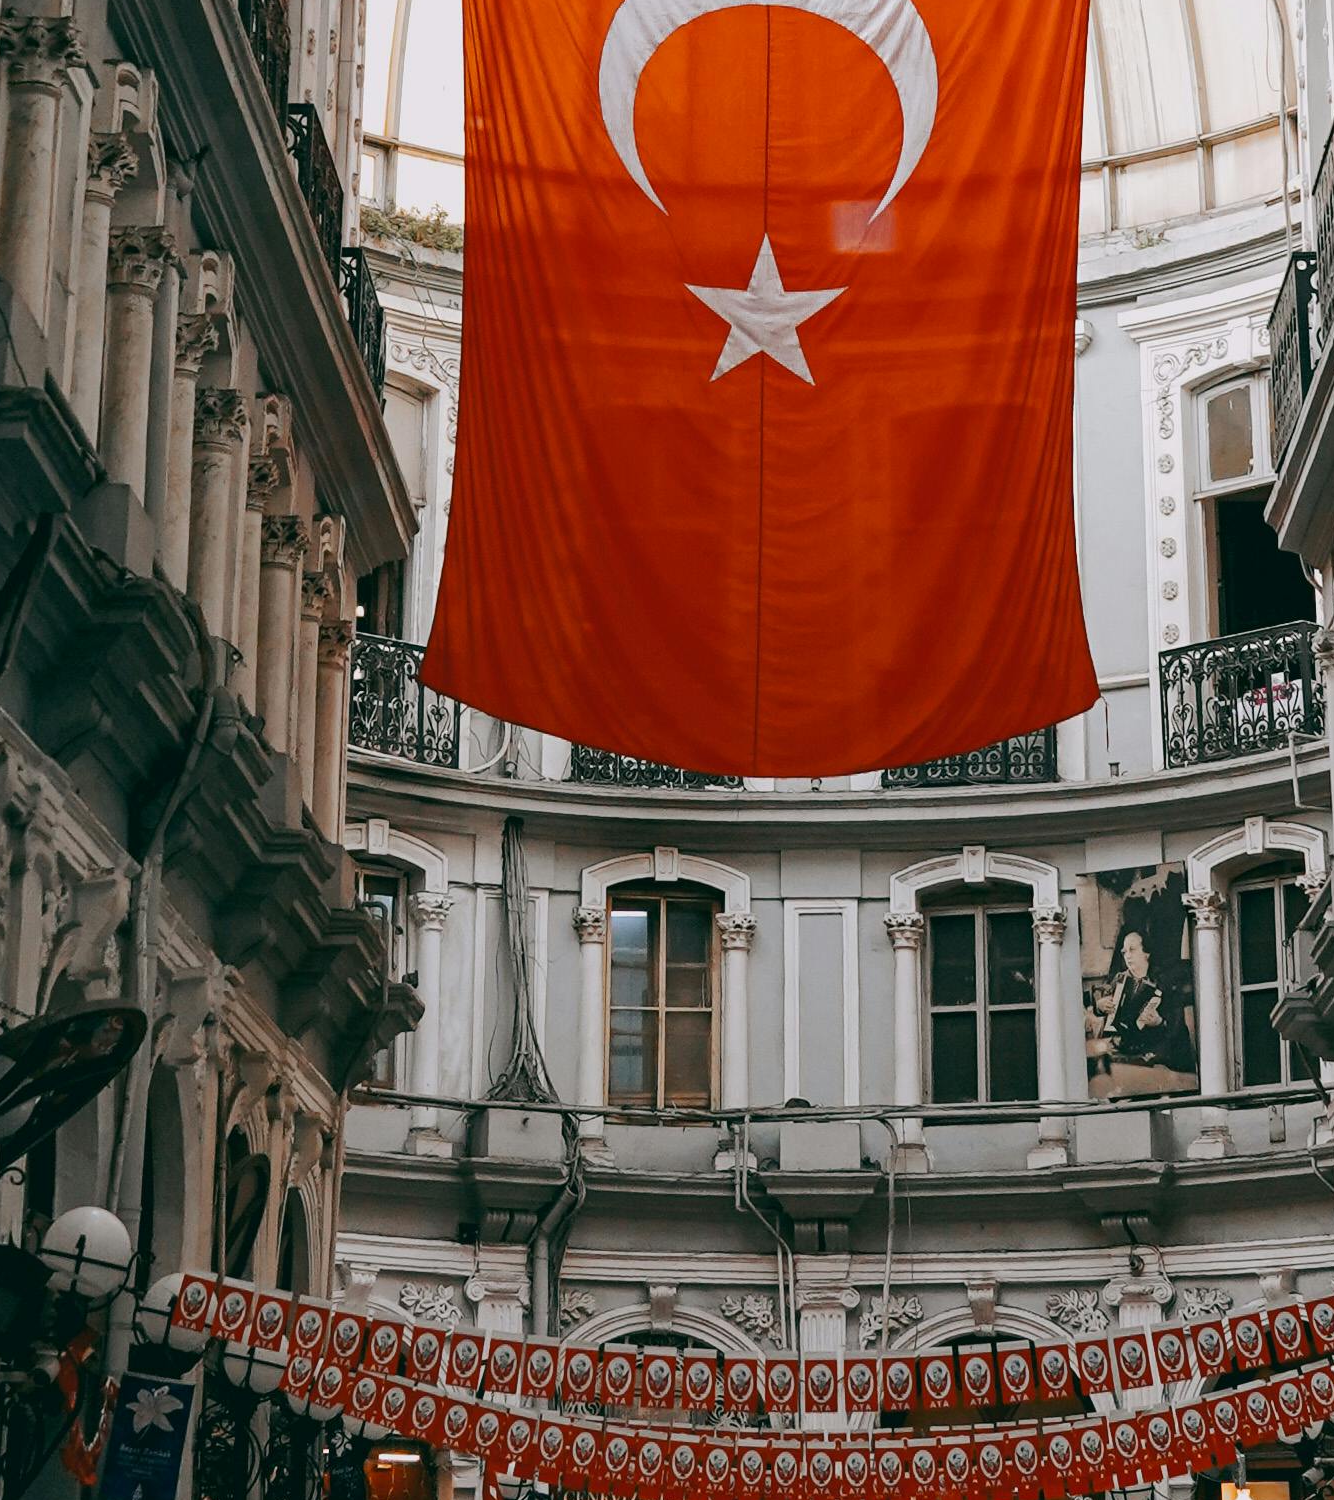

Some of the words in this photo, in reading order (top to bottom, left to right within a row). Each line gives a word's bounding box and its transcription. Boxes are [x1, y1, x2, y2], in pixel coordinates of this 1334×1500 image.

[178, 1320, 197, 1329] ATA
[216, 1330, 236, 1340] ATA
[254, 1339, 273, 1349] ATA
[293, 1349, 312, 1358] ATA
[1284, 1351, 1304, 1360] ATA
[332, 1357, 350, 1366] ATA
[1246, 1359, 1265, 1368] ATA
[370, 1364, 389, 1373] ATA
[1206, 1367, 1226, 1376] ATA
[411, 1372, 431, 1381] ATA
[1167, 1374, 1186, 1382] ATA
[452, 1378, 471, 1387] ATA
[1128, 1379, 1147, 1388] ATA
[283, 1385, 300, 1396] ATA
[491, 1384, 510, 1392] ATA
[1089, 1385, 1108, 1393] ATA
[528, 1389, 547, 1397] ATA
[568, 1393, 588, 1401] ATA
[1048, 1391, 1067, 1399] ATA
[315, 1399, 331, 1408] ATA
[607, 1397, 626, 1405] ATA
[970, 1397, 990, 1406] ATA
[349, 1410, 366, 1419] ATA
[380, 1419, 396, 1428] ATA
[1288, 1417, 1306, 1426] ATA
[410, 1429, 426, 1438] ATA
[1257, 1425, 1274, 1434] ATA
[442, 1438, 459, 1447] ATA
[1225, 1434, 1241, 1443] ATA
[474, 1446, 490, 1455] ATA
[1192, 1443, 1209, 1451] ATA
[505, 1454, 523, 1463] ATA
[1156, 1452, 1173, 1460] ATA
[539, 1461, 556, 1469] ATA
[1123, 1458, 1140, 1467] ATA
[1089, 1464, 1105, 1473] ATA
[605, 1472, 622, 1481] ATA
[639, 1476, 657, 1485] ATA
[1021, 1475, 1038, 1483] ATA
[673, 1480, 690, 1488] ATA
[951, 1483, 968, 1491] ATA
